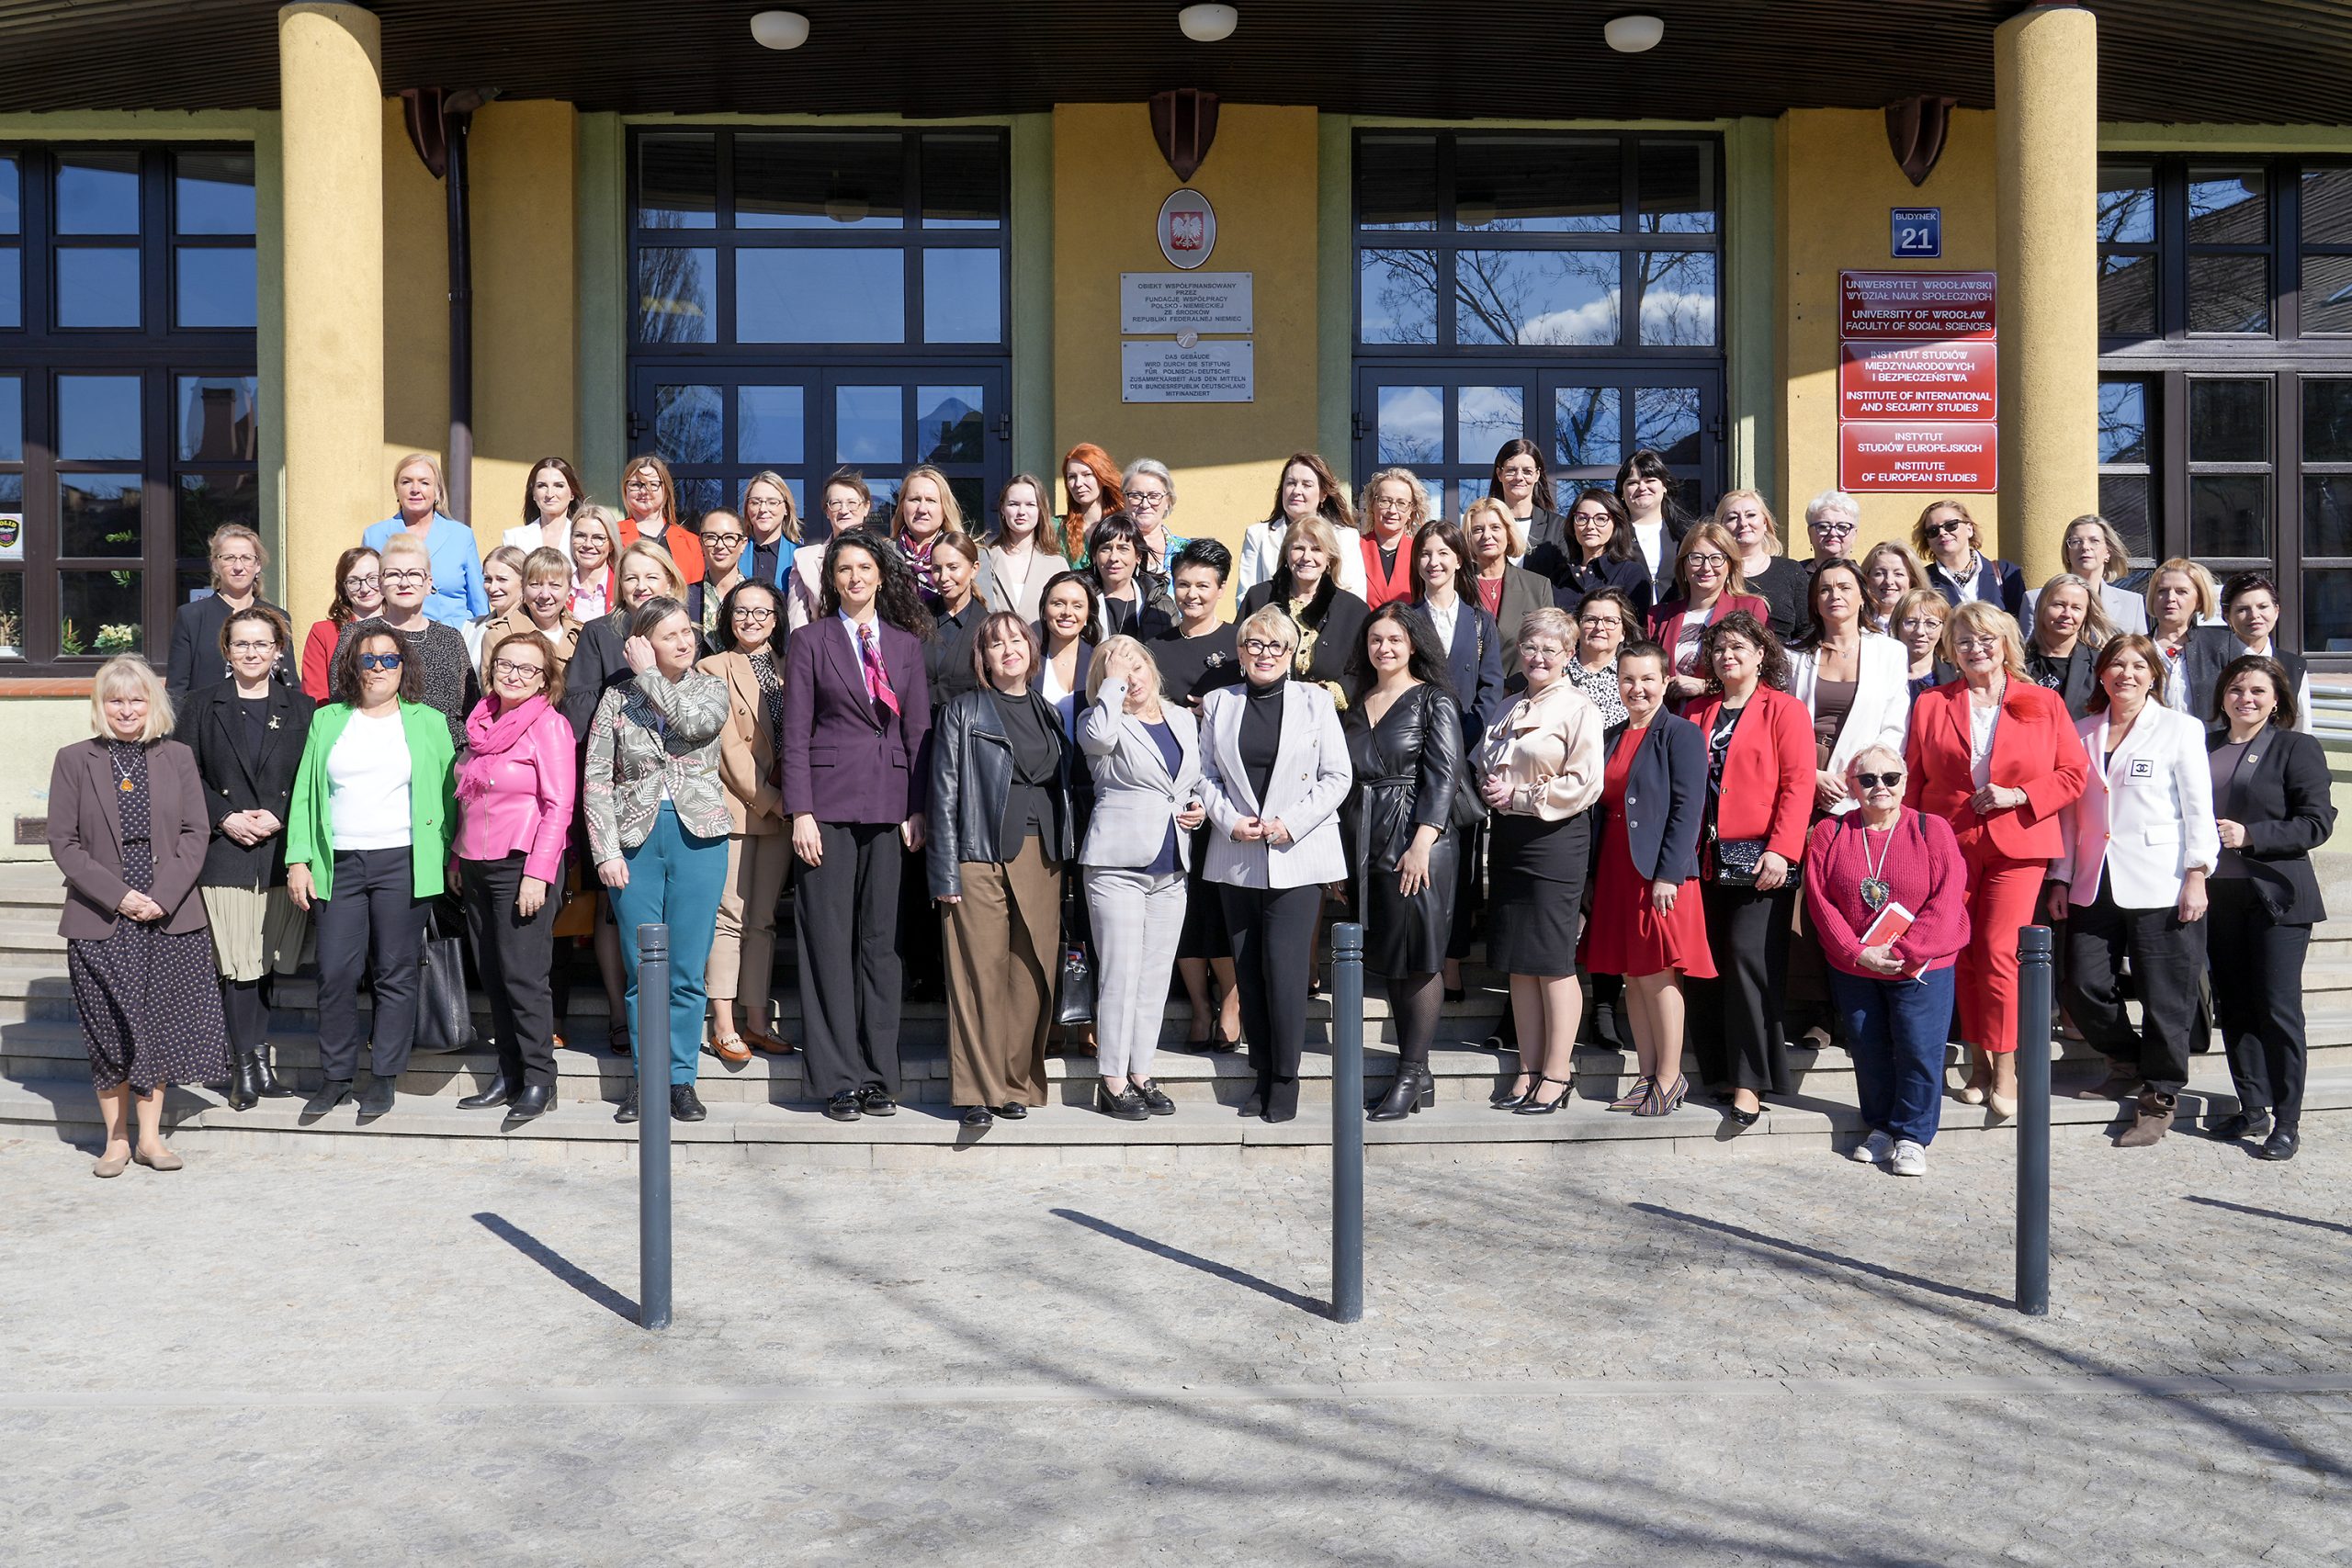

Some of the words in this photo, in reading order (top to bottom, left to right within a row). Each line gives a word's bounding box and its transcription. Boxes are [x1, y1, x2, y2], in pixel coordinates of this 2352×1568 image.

[1901, 228, 1933, 249] 21
[1846, 280, 1917, 289] UNIWERSYTET
[1922, 281, 1992, 289] WROCŁAWSKI
[1847, 291, 1890, 300] WYDZIAŁ
[1892, 292, 1919, 300] NAUK
[1922, 292, 1992, 301] SPOŁECZNYCH
[1852, 310, 1913, 319] UNIVERSITY
[1915, 310, 1929, 319] OF
[1932, 310, 1986, 319] WROCŁAW
[1846, 321, 1890, 331] FACULTY
[1893, 321, 1906, 331] OF
[1908, 321, 1942, 331] SOCIAL
[1945, 322, 1992, 331] SCIENCES
[1871, 350, 1919, 359] INSTYTUT
[1922, 350, 1968, 360] STUDIÓW
[1865, 362, 1975, 371] MIĘDZYNARODOWYCH
[1872, 373, 1875, 381] I
[1878, 372, 1968, 382] BEZPIECZEŃSTWA
[1846, 391, 1897, 400] INSTITUTE
[1899, 391, 1913, 400] OF
[1915, 391, 1992, 400] INTERNATIONAL
[1860, 403, 1883, 412] AND
[1885, 403, 1934, 412] SECURITY
[1936, 403, 1979, 412] STUDIES
[1894, 433, 1944, 441] INSTYTUT
[1858, 442, 1905, 453] STUDIÓW
[1906, 444, 1983, 453] EUROPEJSKICH
[1894, 462, 1946, 470] INSTITUTE
[1861, 473, 1876, 481] OF
[1878, 473, 1933, 482] EUROPEAN
[1935, 473, 1978, 482] STUDIES
